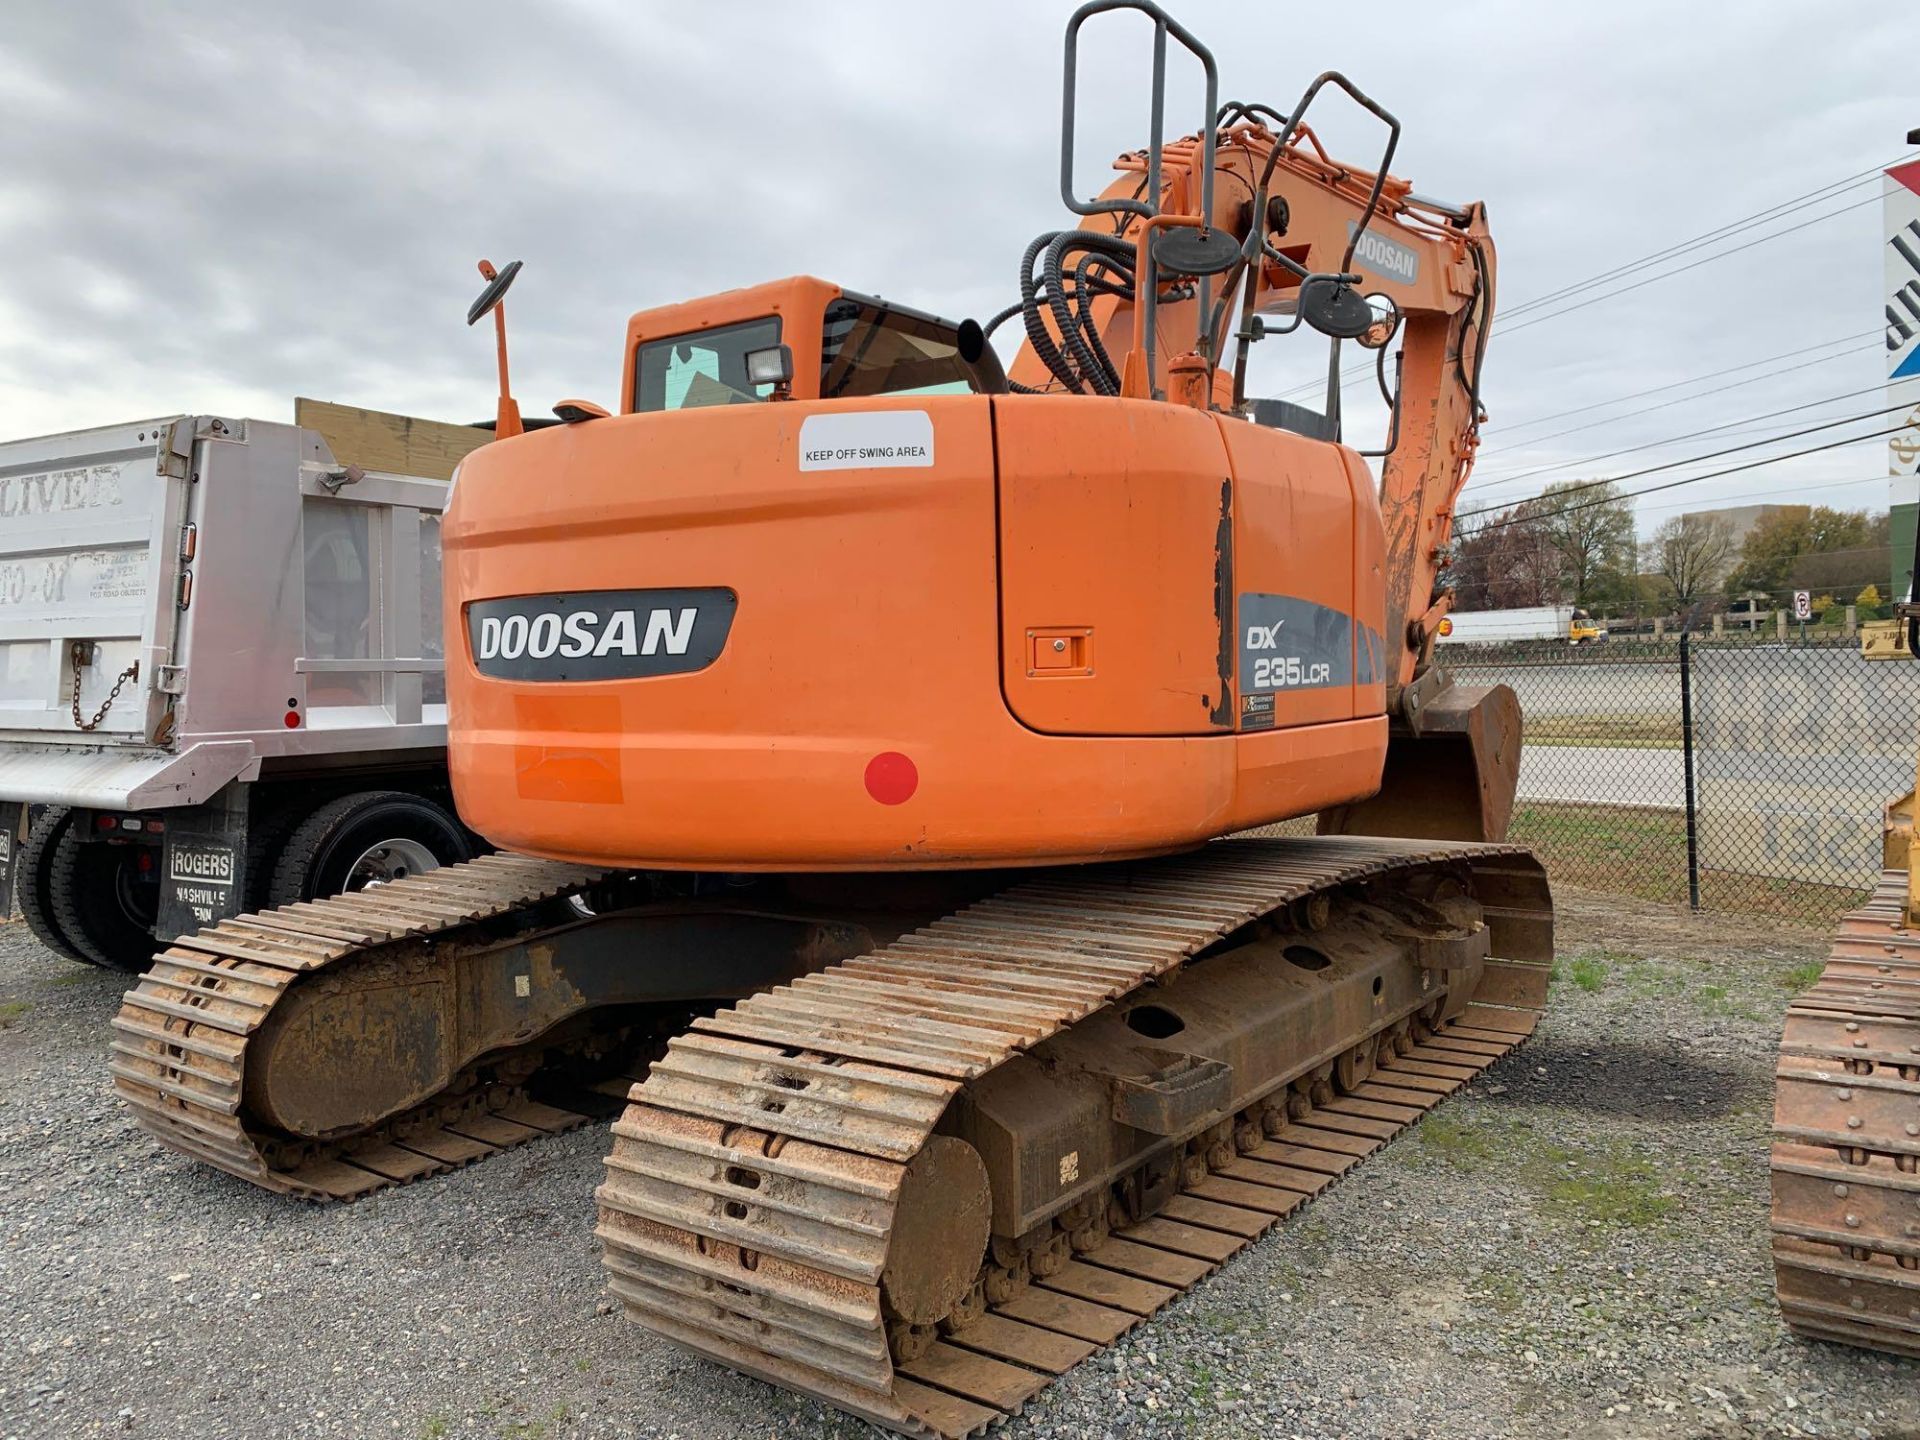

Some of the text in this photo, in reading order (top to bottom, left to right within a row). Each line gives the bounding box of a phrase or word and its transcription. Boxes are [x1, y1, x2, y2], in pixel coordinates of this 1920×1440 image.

[1355, 233, 1414, 278] DOOSAN
[805, 446, 926, 461] KEEP OFF SWING AREA
[479, 608, 698, 660] DOOSAN
[1246, 620, 1285, 649] DX
[1254, 657, 1330, 688] 235LCR
[175, 851, 229, 877] ROGERS
[176, 887, 226, 906] NASHVILLE
[191, 906, 212, 922] ENN
